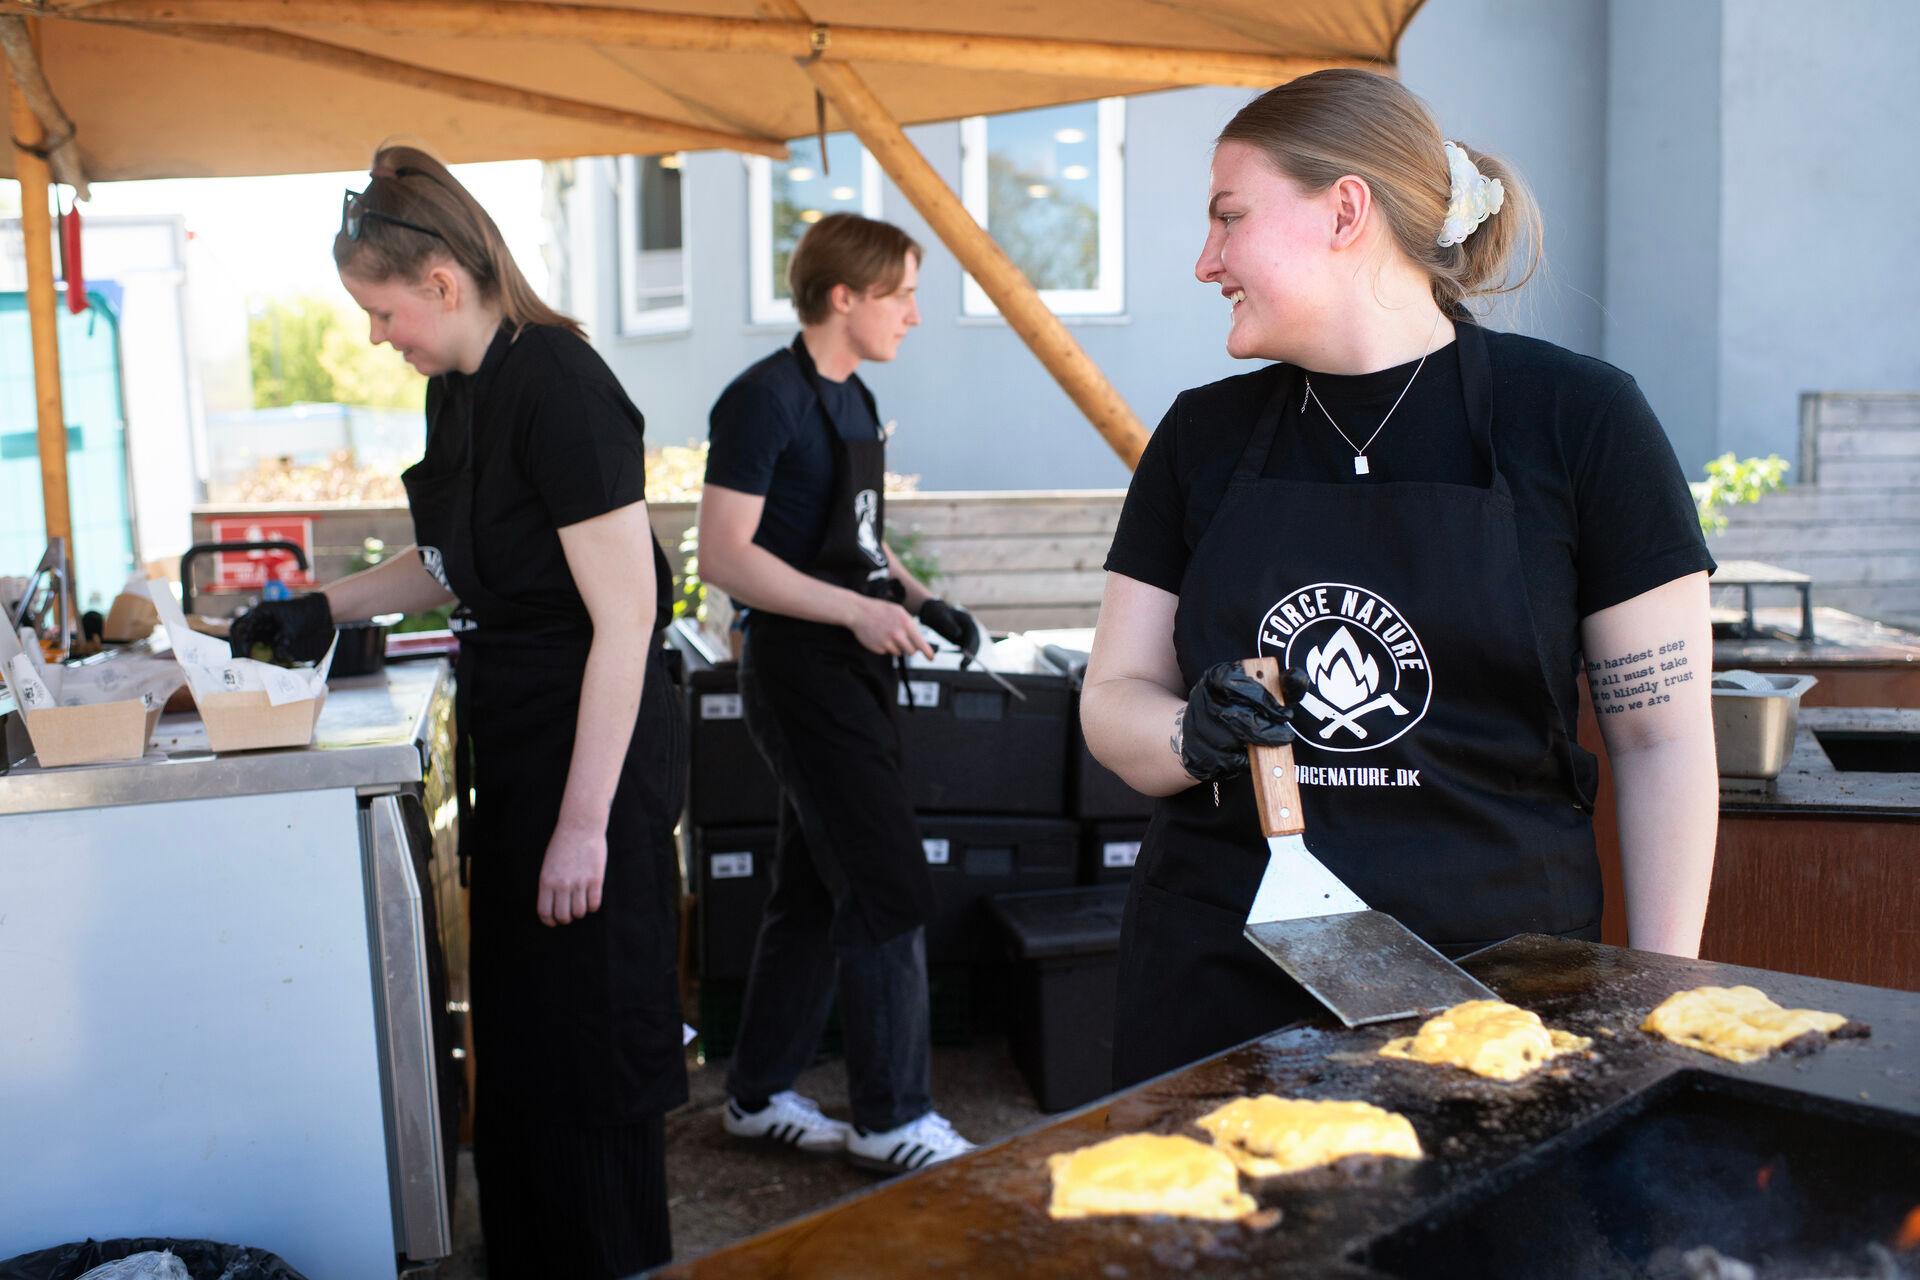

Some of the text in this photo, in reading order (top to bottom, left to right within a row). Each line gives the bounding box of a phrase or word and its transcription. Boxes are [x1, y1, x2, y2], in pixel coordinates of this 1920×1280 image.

[1262, 588, 1425, 671] FORCE NATURE
[1604, 649, 1653, 669] hardest
[1658, 640, 1685, 655] step
[1602, 674, 1621, 686] all
[1624, 666, 1655, 682] must
[1660, 656, 1688, 671] take
[1600, 691, 1611, 701] to
[1613, 680, 1659, 698] blindly
[1664, 671, 1694, 687] trust
[1604, 705, 1625, 714] who
[1628, 700, 1643, 710] we
[1647, 693, 1671, 706] are
[1291, 764, 1421, 787] ORCENATURE.DK
